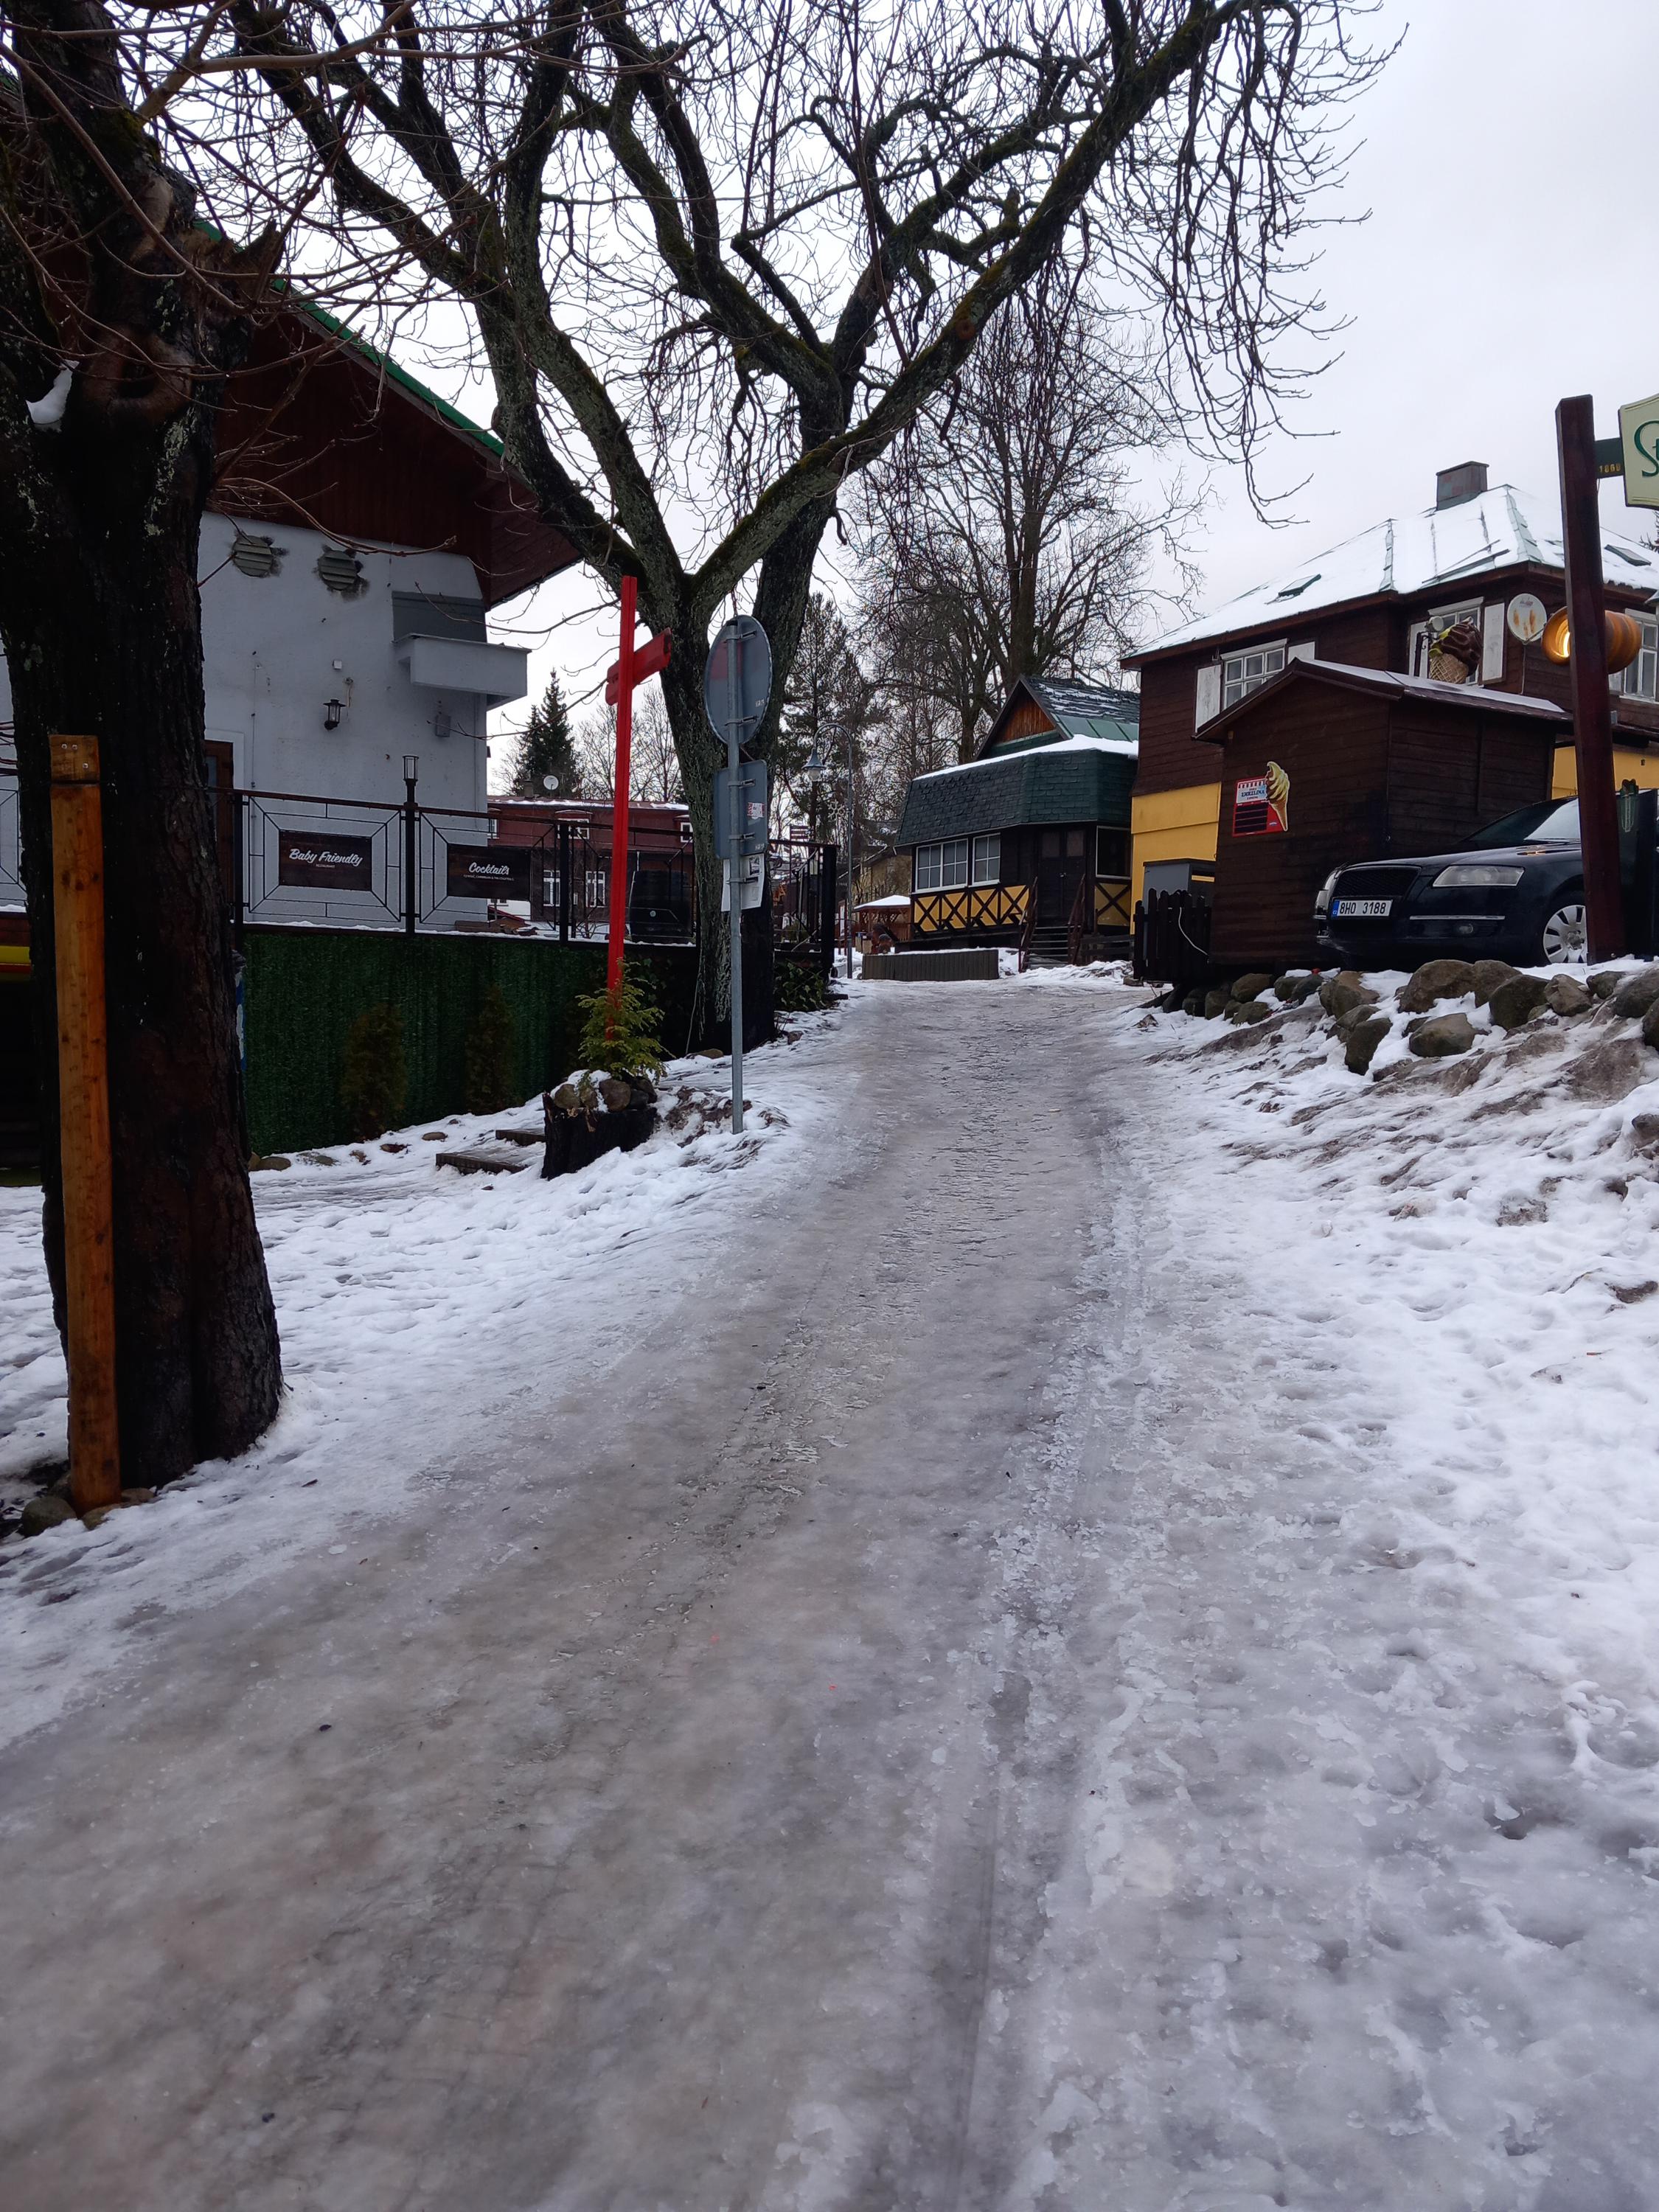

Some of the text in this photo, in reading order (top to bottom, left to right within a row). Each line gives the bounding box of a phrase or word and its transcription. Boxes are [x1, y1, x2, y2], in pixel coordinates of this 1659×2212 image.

[289, 849, 363, 866] Baby Friendly
[468, 862, 509, 875] Cocktails
[1363, 902, 1386, 914] 3188
